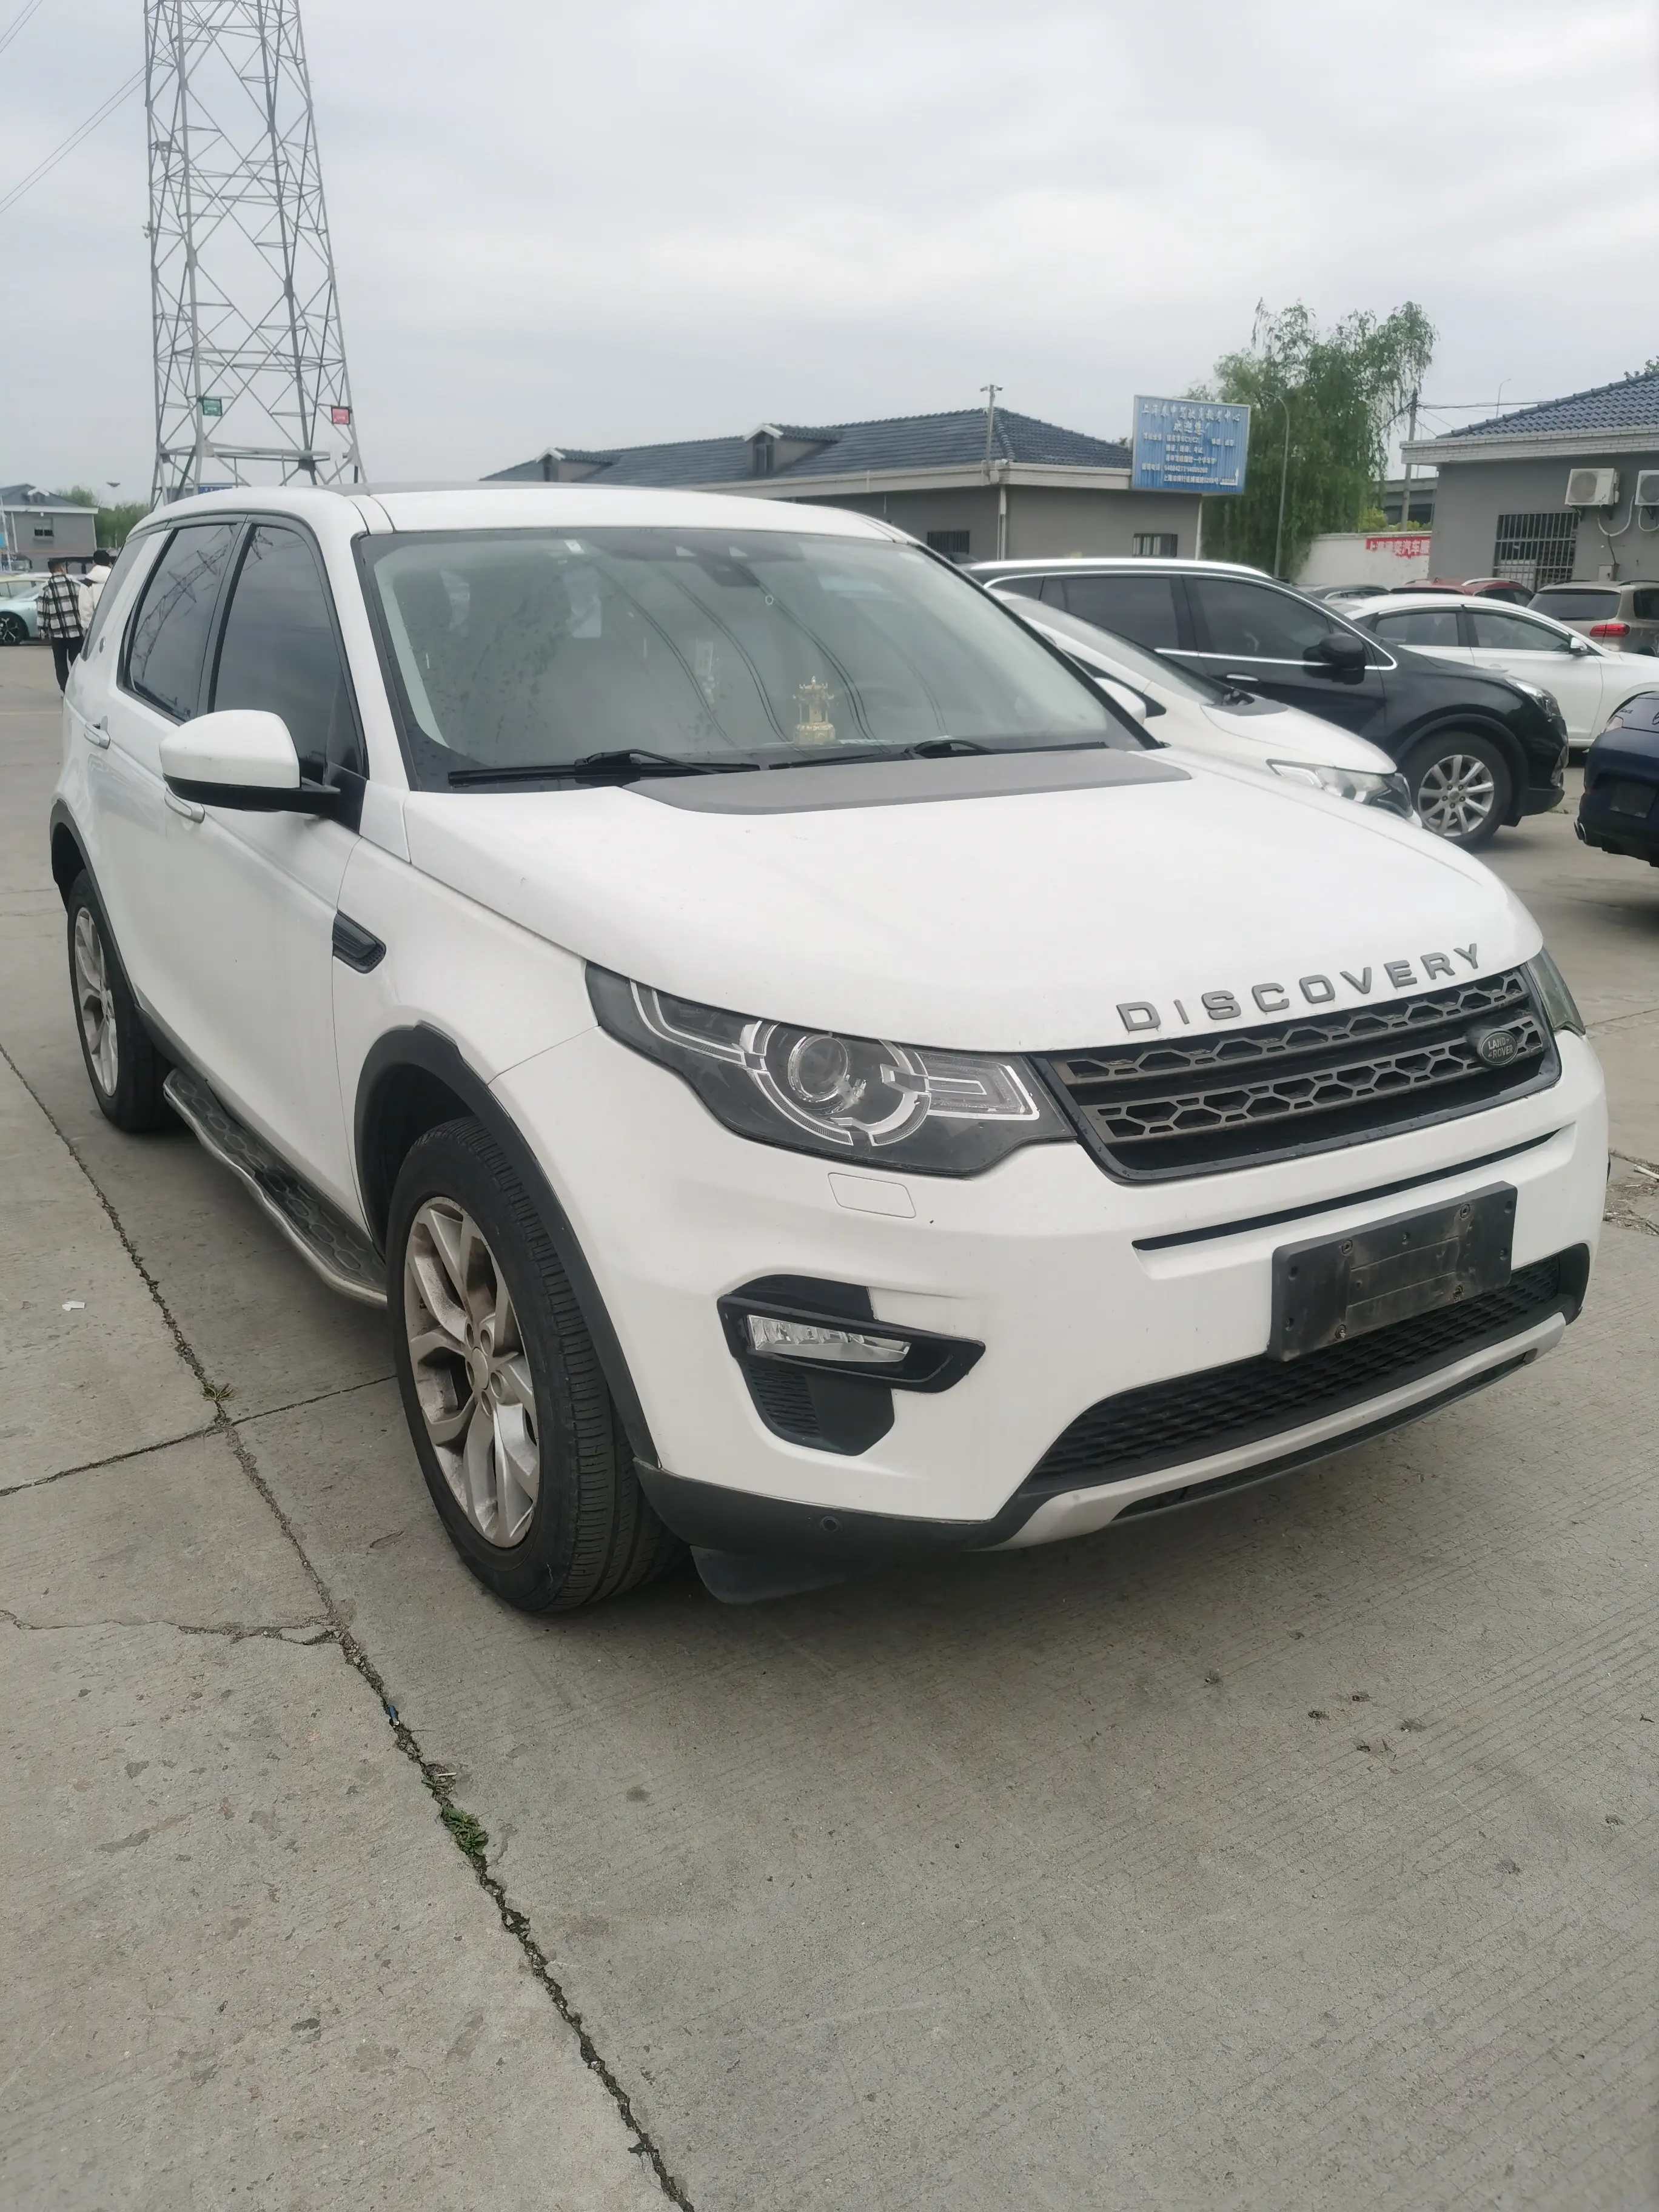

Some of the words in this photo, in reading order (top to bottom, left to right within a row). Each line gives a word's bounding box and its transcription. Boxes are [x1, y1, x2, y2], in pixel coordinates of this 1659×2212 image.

[1116, 943, 1480, 1031] DISCOVERY
[1487, 1037, 1506, 1050] LAND
[1492, 1044, 1513, 1059] ROVER
